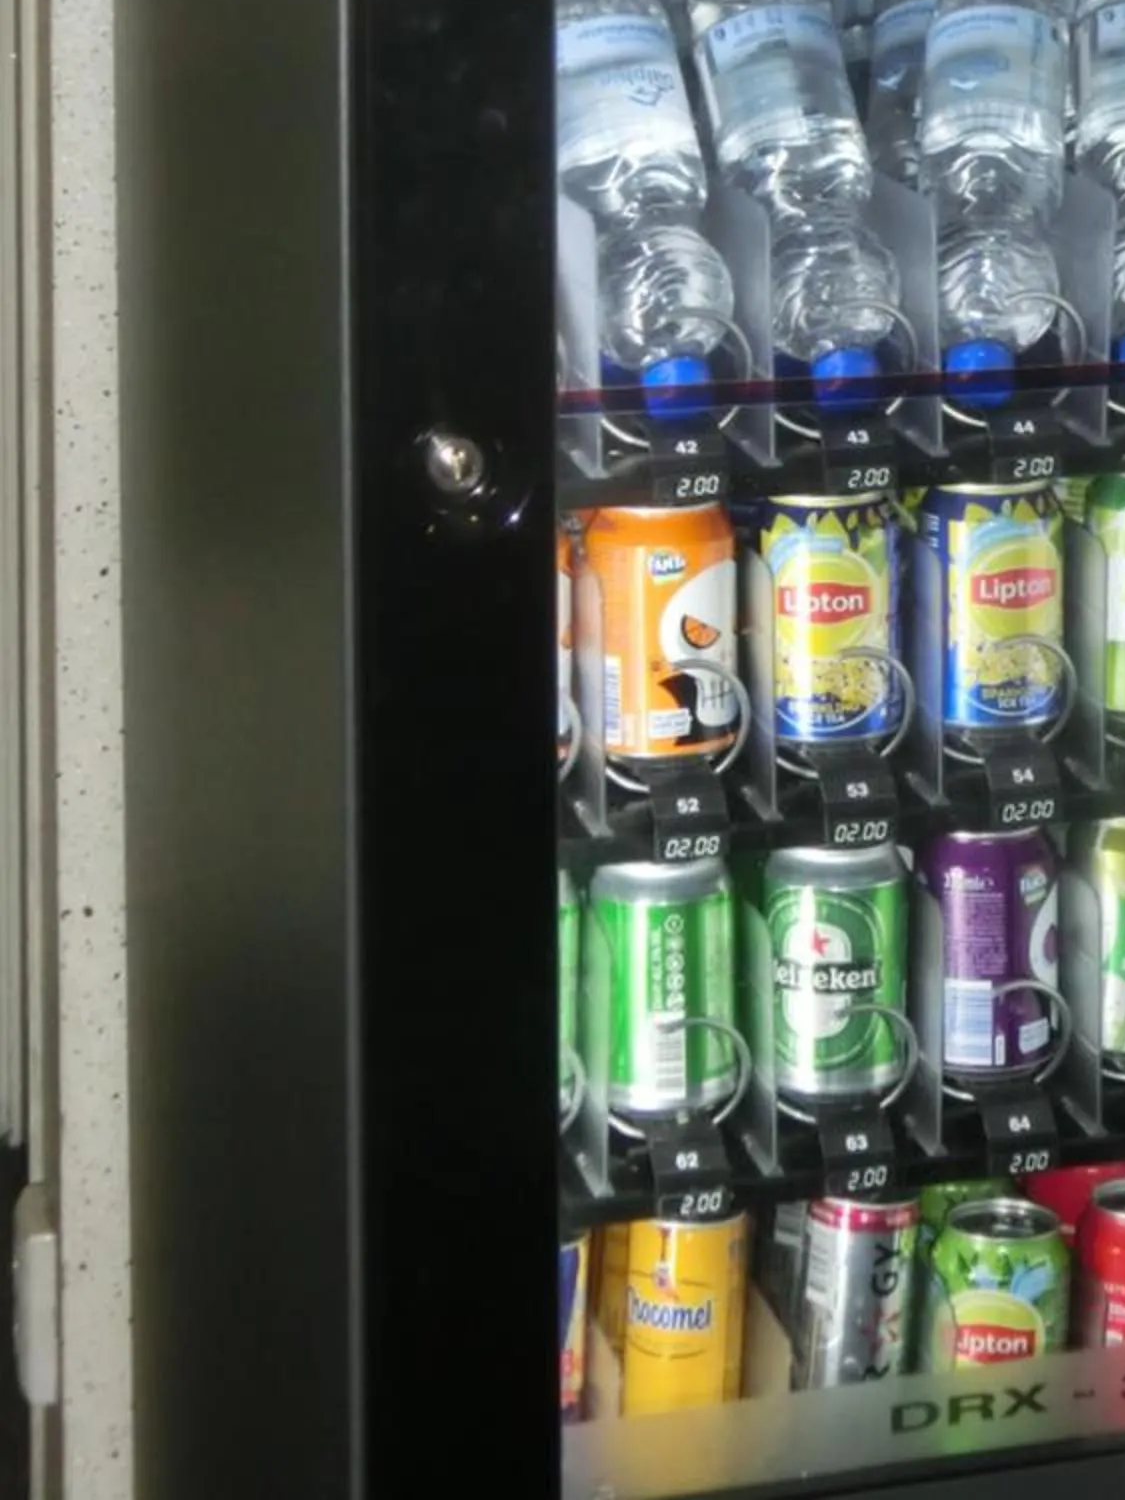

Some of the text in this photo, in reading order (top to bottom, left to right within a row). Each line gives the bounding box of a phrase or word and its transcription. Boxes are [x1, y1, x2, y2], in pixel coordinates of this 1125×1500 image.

[848, 430, 869, 443] 43
[1014, 421, 1034, 434] 44
[676, 441, 697, 454] 42
[677, 475, 719, 497] 2.00
[848, 468, 890, 488] 2.00
[784, 589, 864, 614] Lpton
[979, 579, 1053, 604] Lipton
[1013, 768, 1034, 783] 54
[847, 782, 869, 798] 53
[677, 798, 699, 814] 52
[1003, 800, 1054, 822] 02.00
[834, 821, 888, 843] 02.00
[775, 962, 877, 991] eieken
[1009, 1116, 1030, 1132] 64
[846, 1134, 868, 1151] 63
[676, 1152, 698, 1170] 62
[1010, 1151, 1049, 1173] 2.00
[848, 1166, 887, 1191] 2.00
[681, 1190, 722, 1216] 2.00
[628, 1286, 713, 1330] hocomel
[890, 1383, 1048, 1435] DRX
